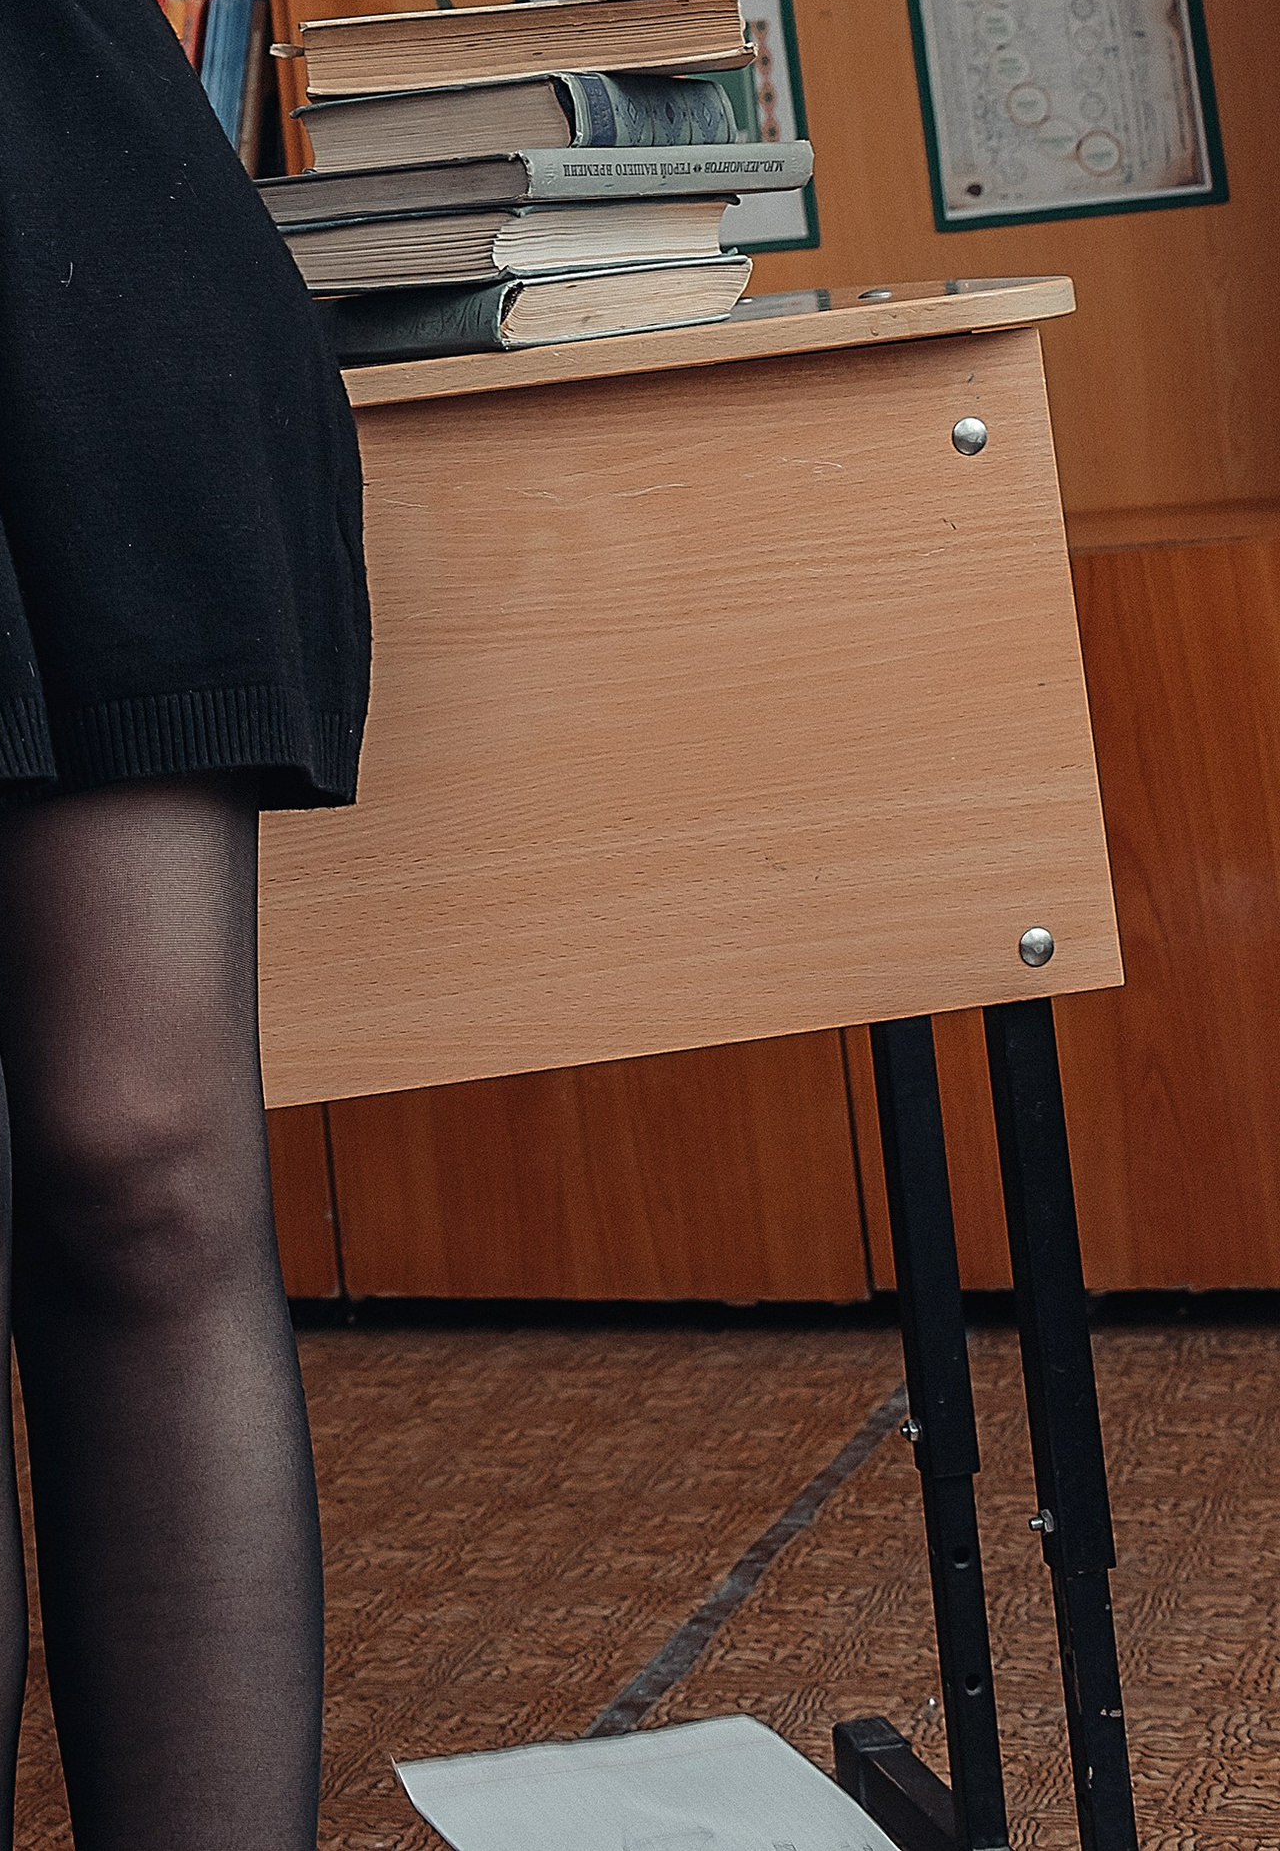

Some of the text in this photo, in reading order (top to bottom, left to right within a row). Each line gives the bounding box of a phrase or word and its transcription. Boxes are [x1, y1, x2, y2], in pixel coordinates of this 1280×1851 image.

[562, 162, 614, 177] ВРЕМЕНИ
[615, 162, 659, 177] НАШЕГО
[659, 161, 692, 179] ГЕРОЙ
